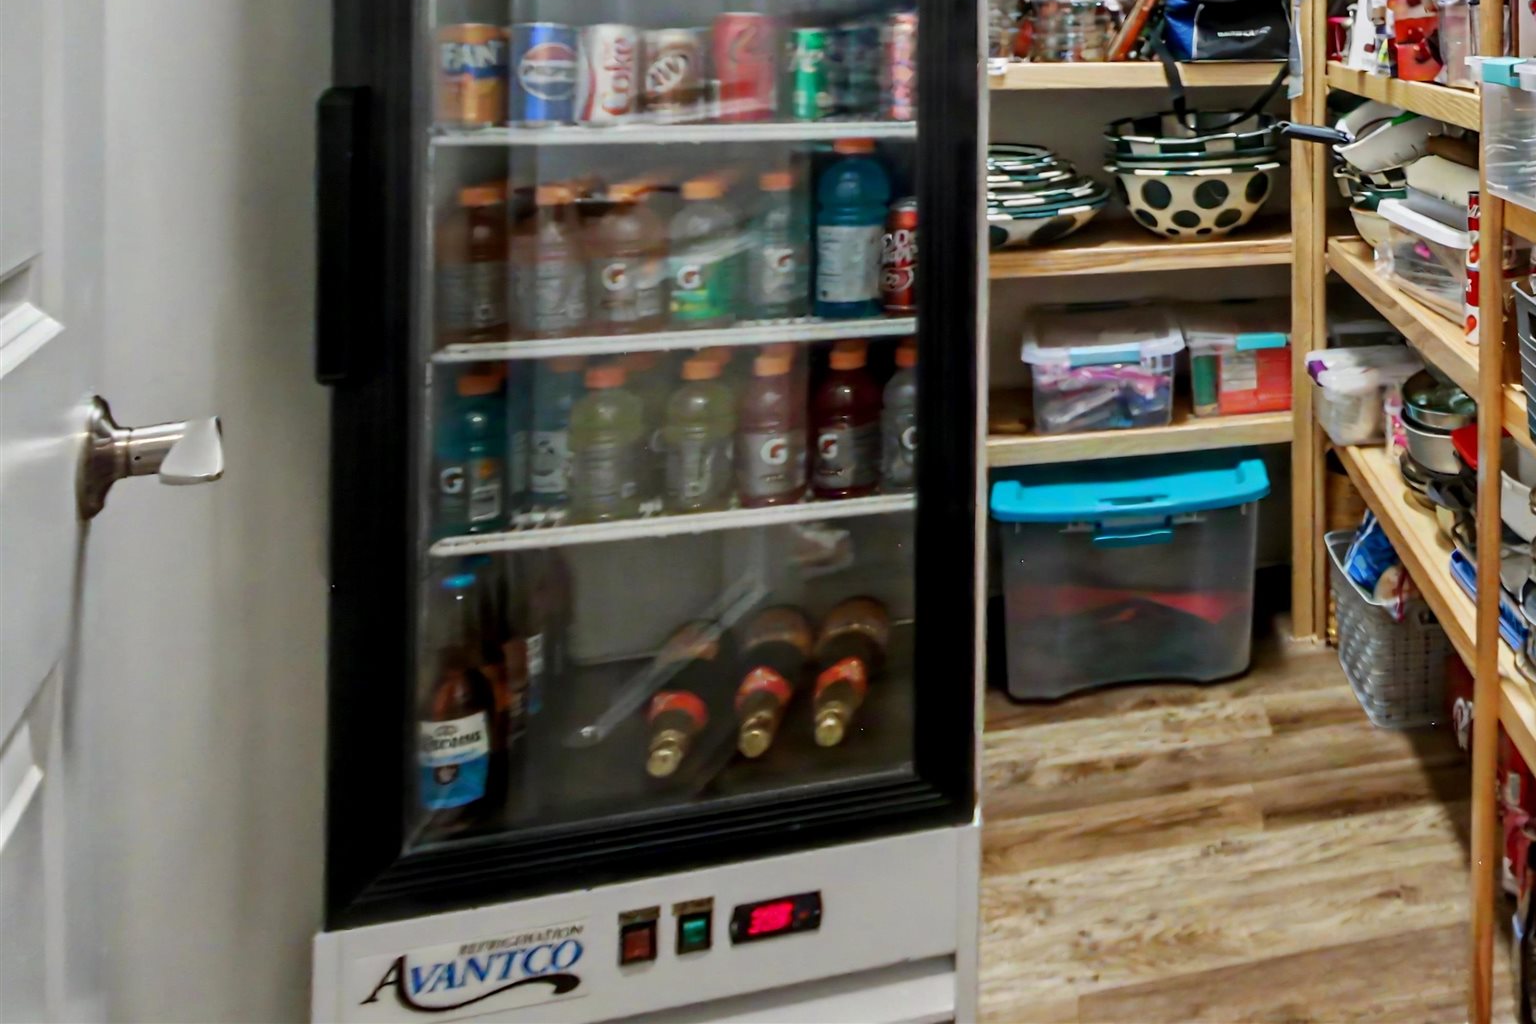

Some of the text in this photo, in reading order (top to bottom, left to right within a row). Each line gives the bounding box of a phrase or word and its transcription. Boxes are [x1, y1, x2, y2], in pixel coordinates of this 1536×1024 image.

[760, 437, 788, 466] G
[818, 433, 839, 460] G
[439, 467, 465, 494] G
[360, 938, 584, 1013] AVANTCO
